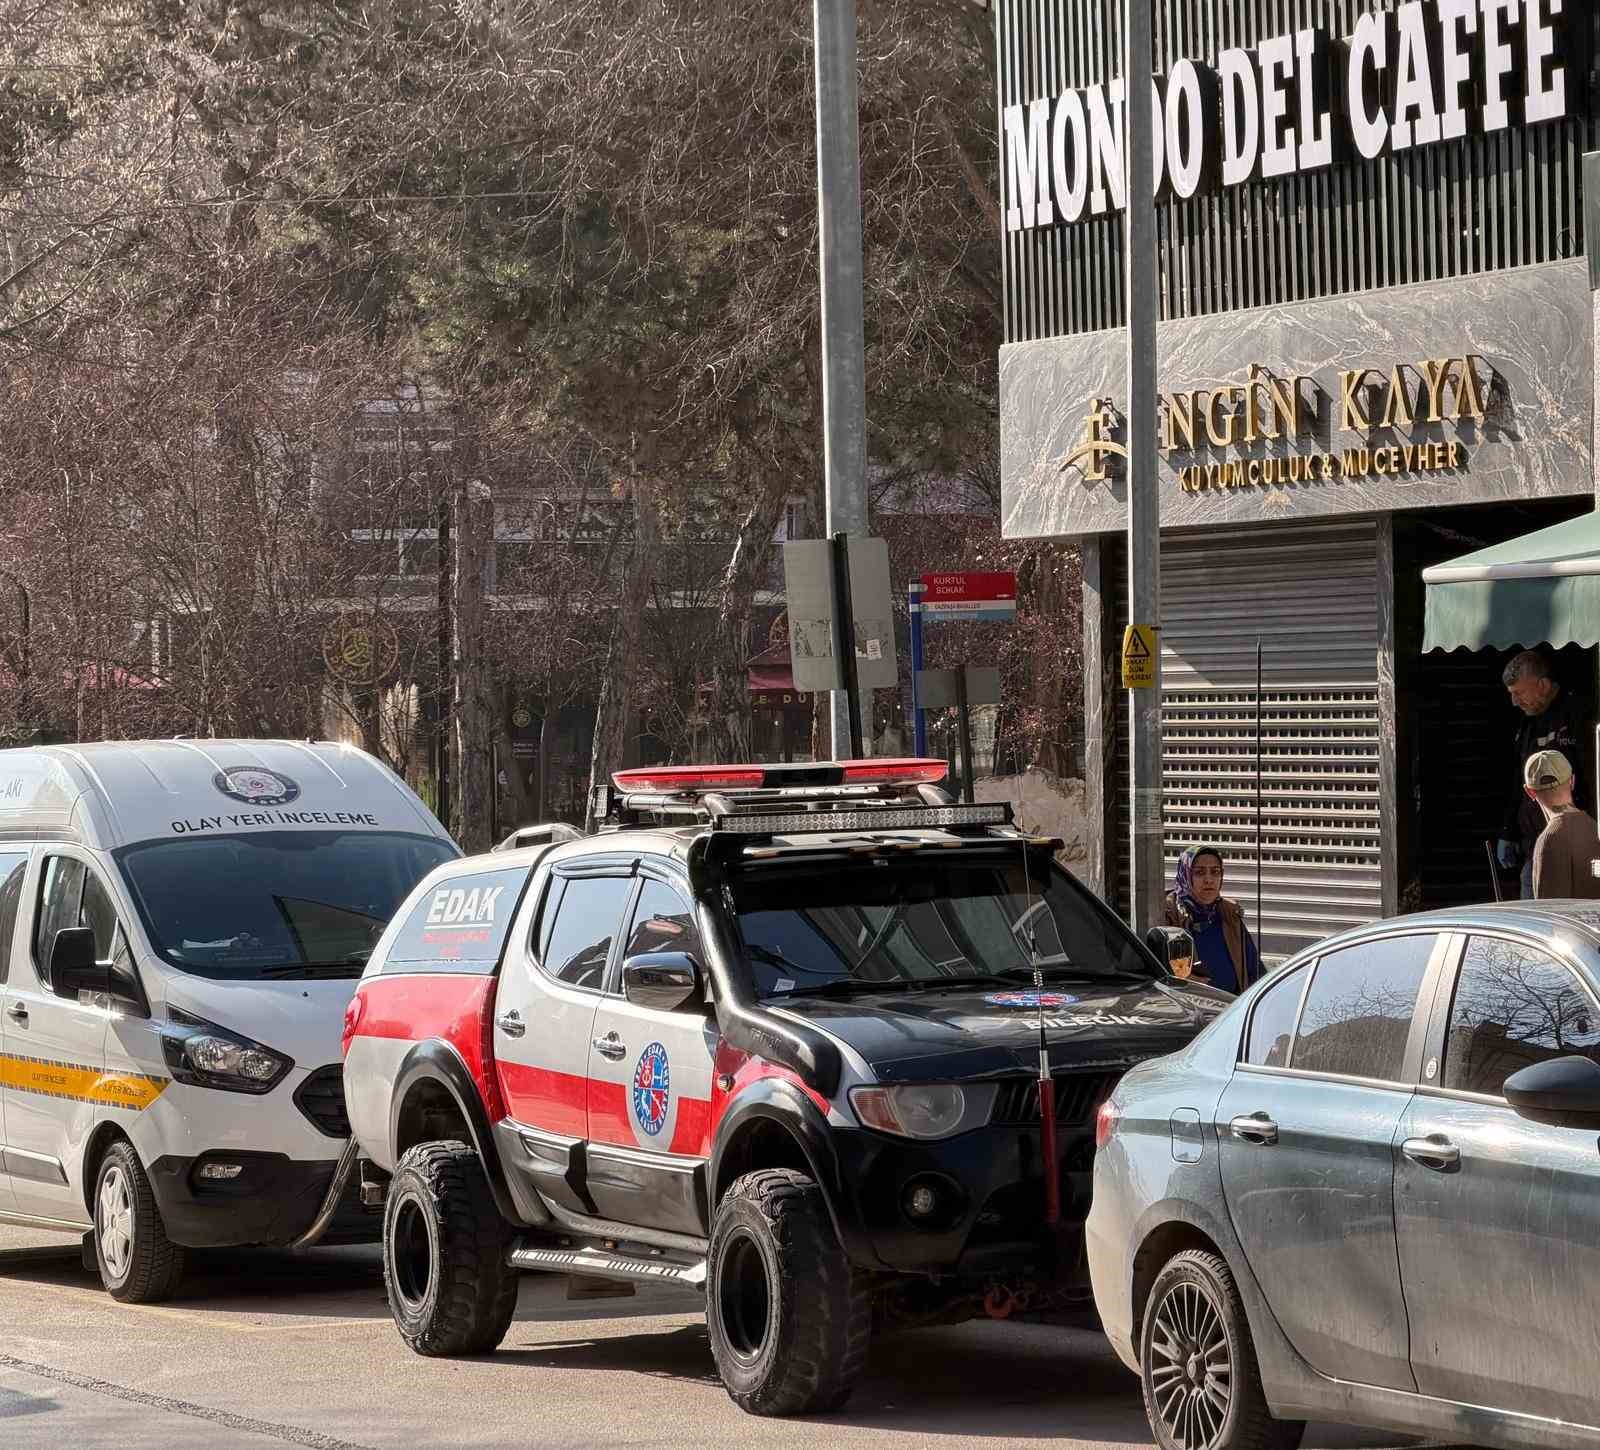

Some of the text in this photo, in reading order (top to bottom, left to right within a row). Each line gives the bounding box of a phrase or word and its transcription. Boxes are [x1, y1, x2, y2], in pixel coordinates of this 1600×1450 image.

[1004, 0, 1566, 232] MONO DEL CAFFE
[1338, 355, 1485, 431] KAYA
[1178, 455, 1314, 492] KUYUMCULUK
[1321, 453, 1333, 478] &
[933, 576, 966, 585] KURTUL
[171, 810, 380, 834] OLAY YERİ İNCELEME
[425, 886, 505, 923] EDAK
